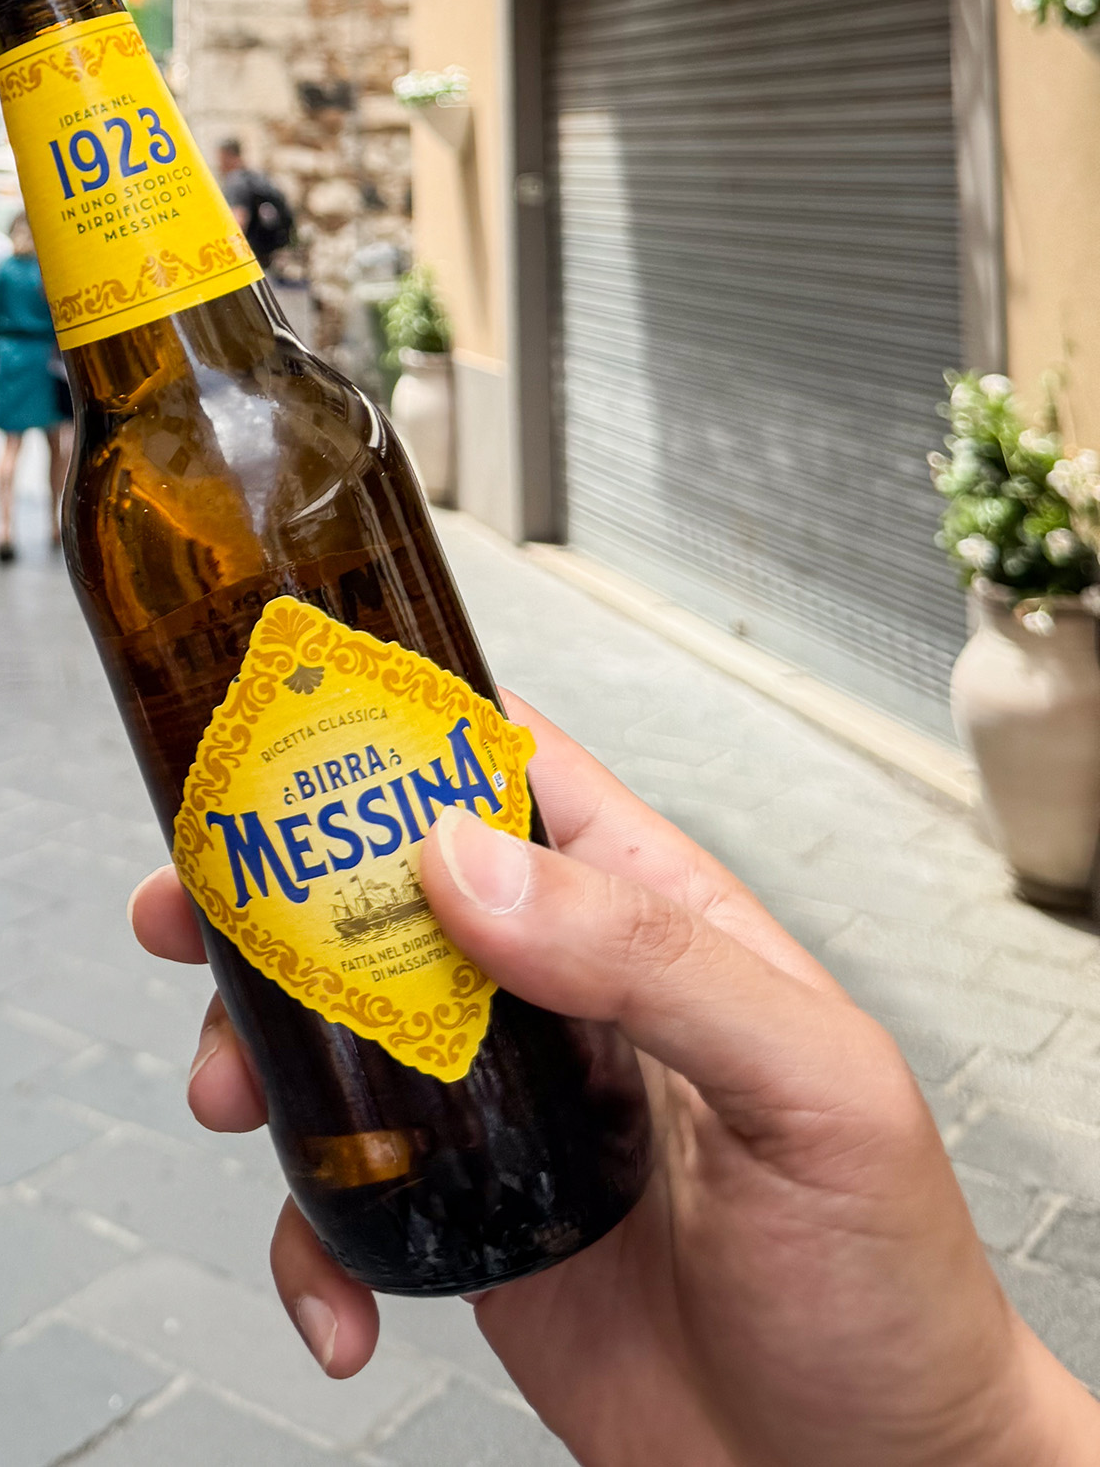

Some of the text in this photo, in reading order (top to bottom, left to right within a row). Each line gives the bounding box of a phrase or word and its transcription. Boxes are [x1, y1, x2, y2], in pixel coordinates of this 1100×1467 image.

[58, 93, 136, 128] IDEATA NEL
[49, 107, 177, 200] 1923
[61, 166, 192, 222] IN UNO STORICO
[77, 185, 192, 234] BIRRIFICIO DI
[104, 208, 180, 243] MESSINA
[259, 707, 388, 765] RICETTA CLASSICA
[293, 744, 387, 800] BIRRA
[206, 717, 502, 908] MESSINA
[340, 927, 445, 973] FATTA NEL BIRRIFI
[371, 945, 451, 983] DI MASSAFRA
